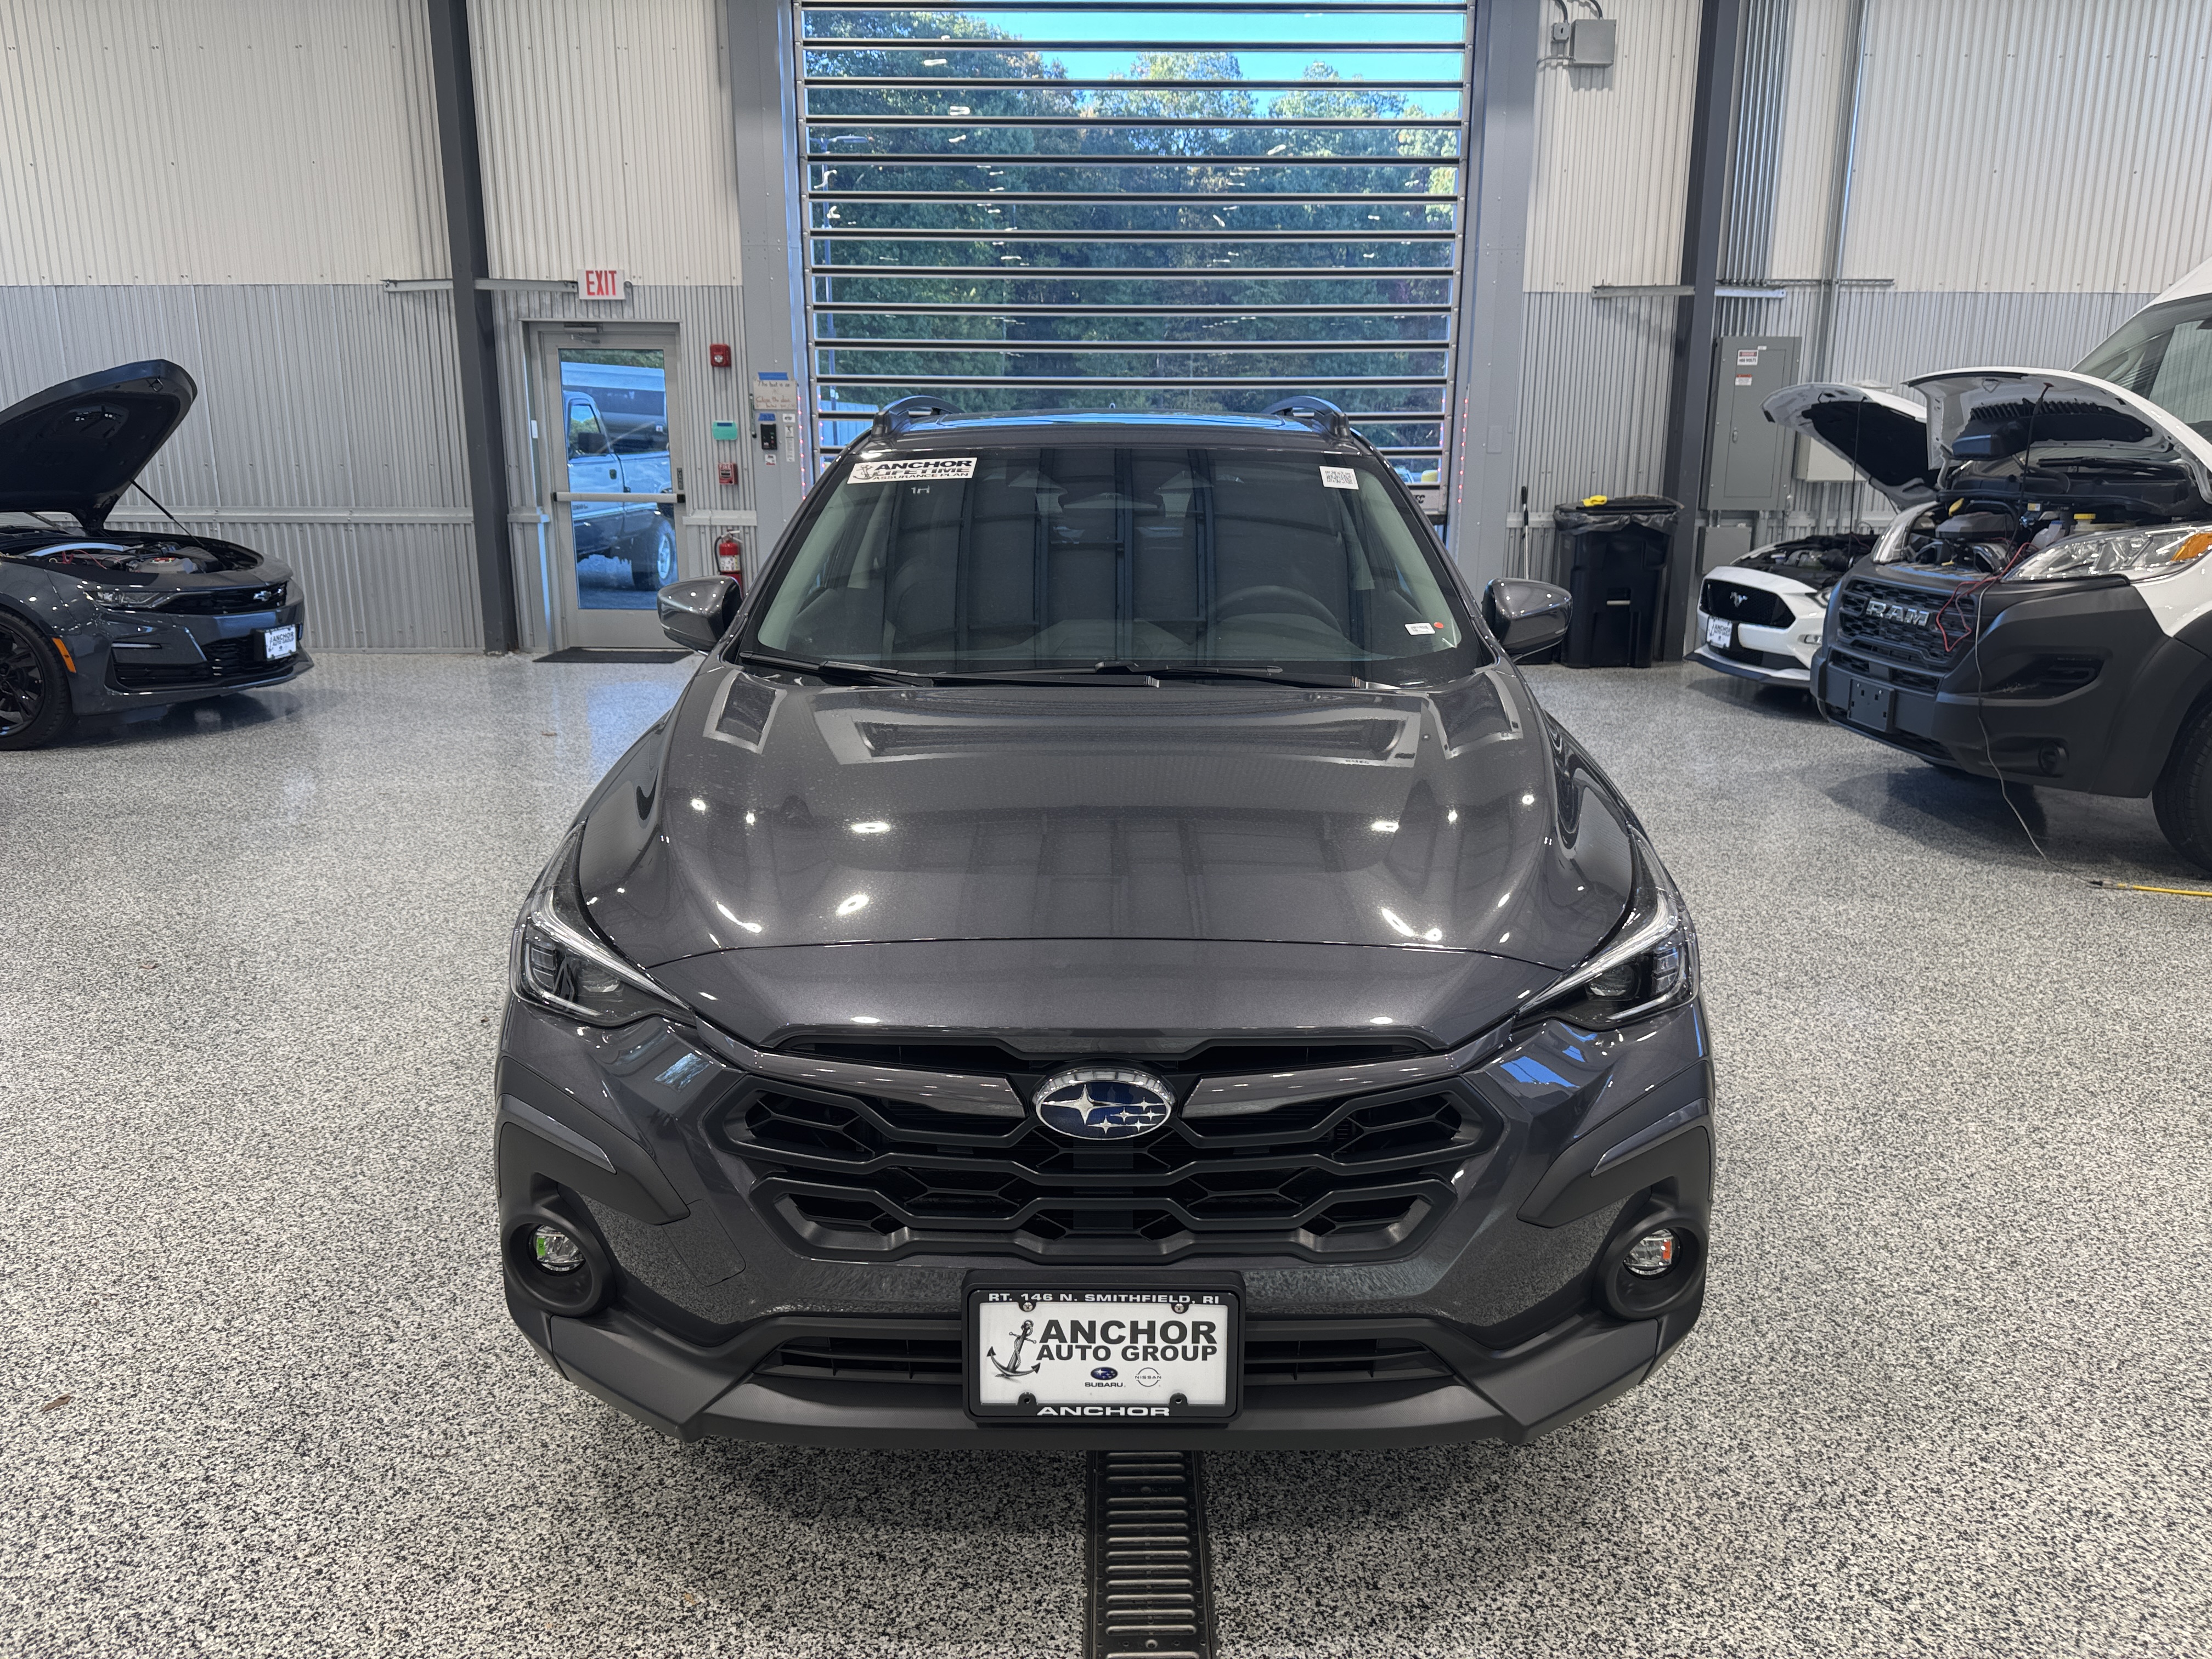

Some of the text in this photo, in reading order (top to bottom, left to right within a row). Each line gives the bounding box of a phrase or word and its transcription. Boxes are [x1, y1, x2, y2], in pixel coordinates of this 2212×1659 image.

[585, 270, 617, 296] EXIT
[873, 466, 970, 476] LIFETIME
[874, 460, 972, 471] ANCHOR
[1866, 600, 1931, 627] RAM
[273, 631, 294, 641] ANCHOR
[989, 1293, 1219, 1304] RT. 146 N. SMITHFIELD, RI
[1039, 1319, 1218, 1345] ANCHOR
[1036, 1344, 1217, 1361] AUTO GROUP
[1037, 1406, 1170, 1417] ANCHOR
